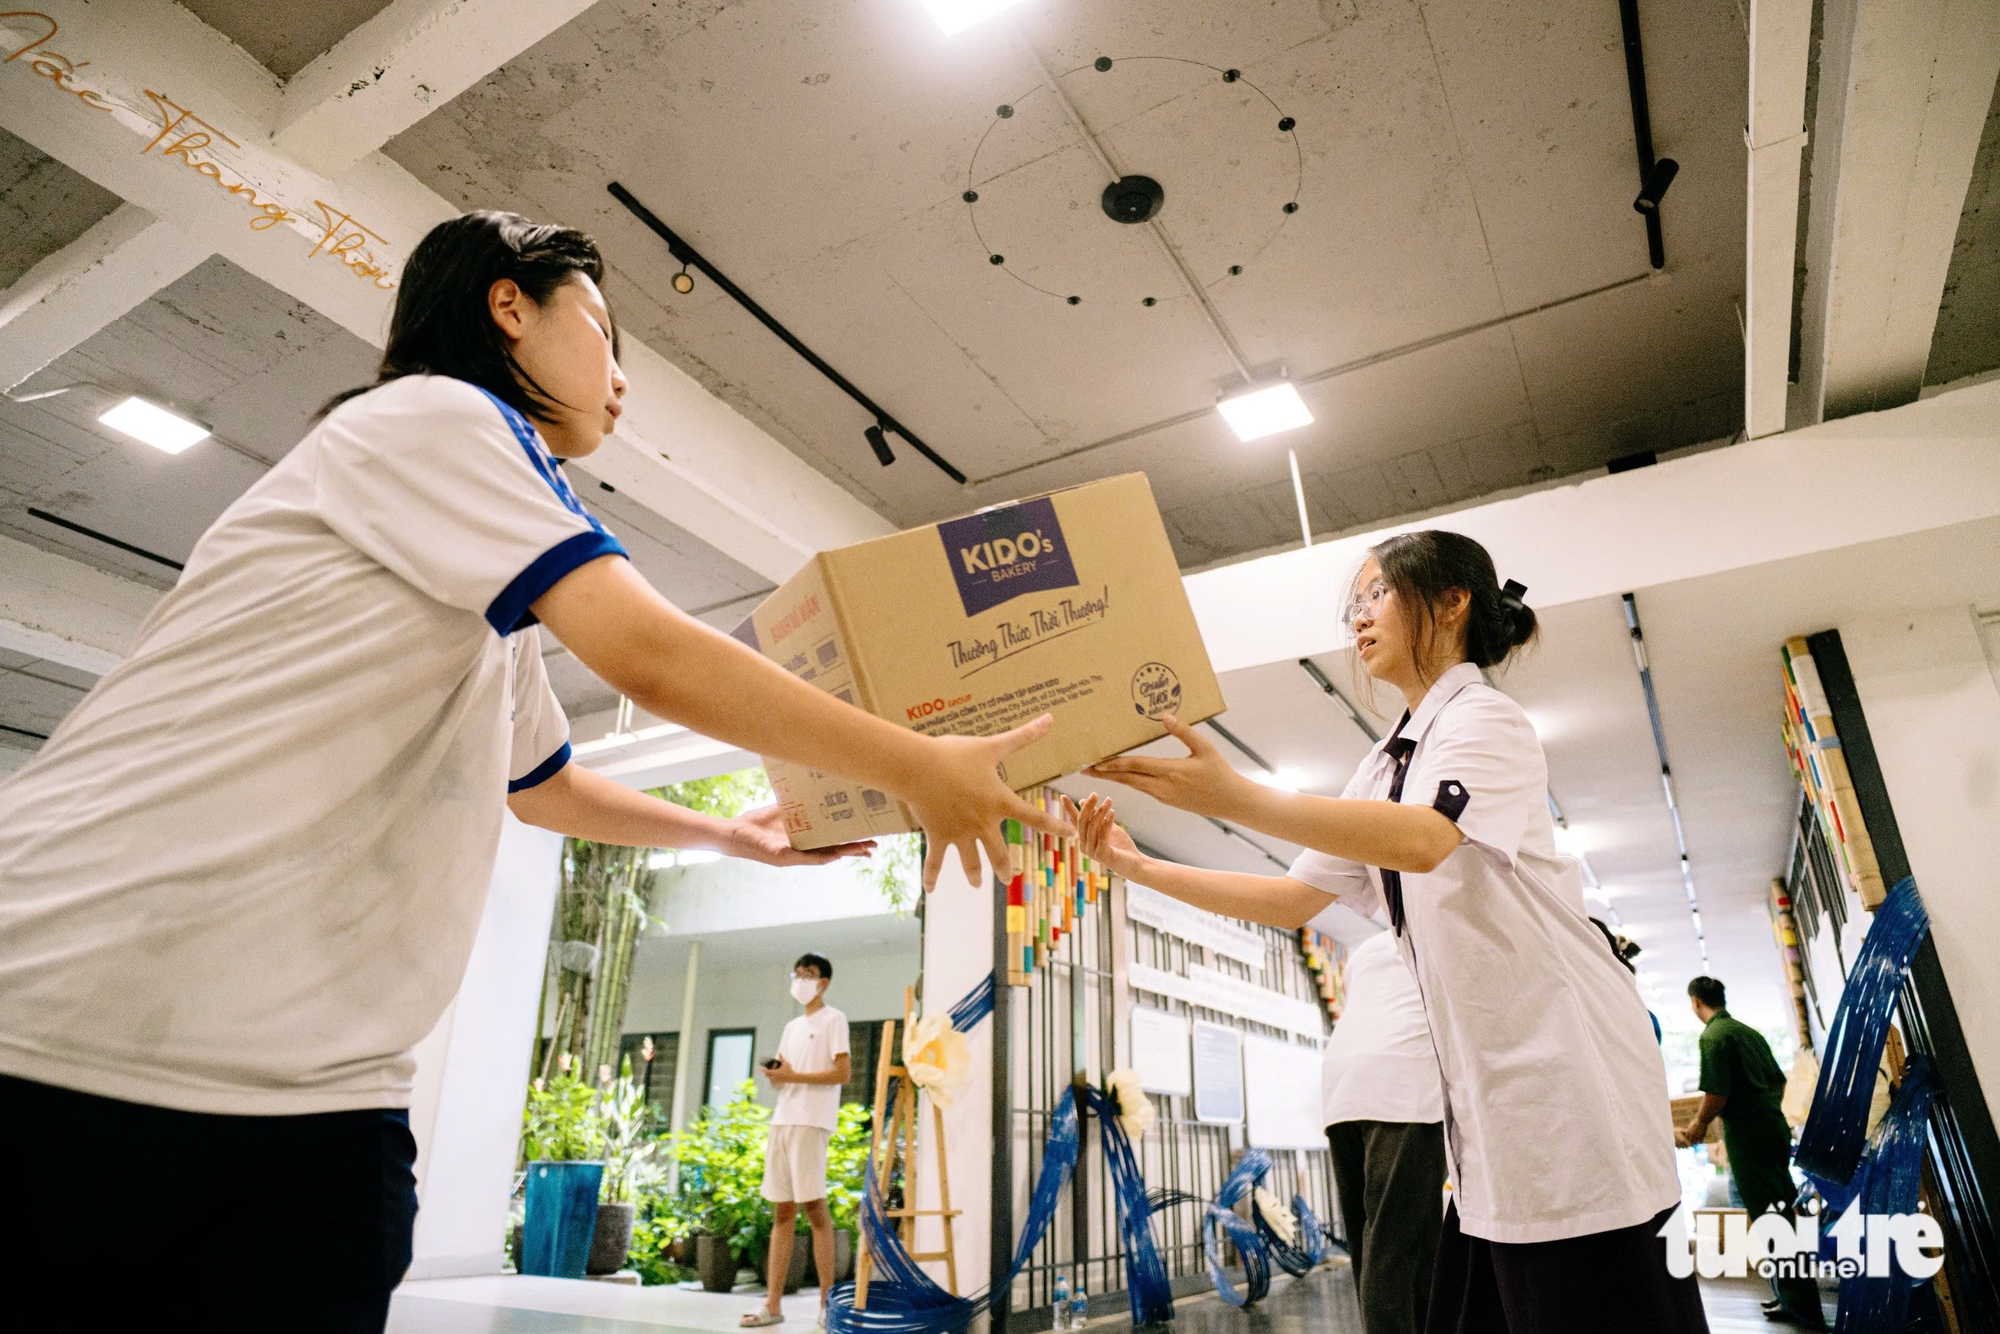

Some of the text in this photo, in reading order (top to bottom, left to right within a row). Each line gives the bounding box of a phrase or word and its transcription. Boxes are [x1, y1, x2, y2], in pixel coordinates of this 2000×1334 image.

[139, 88, 296, 231] Thang
[960, 529, 1054, 575] KIDO's
[990, 560, 1037, 583] BAKERY
[906, 694, 972, 721] KIDO GROUP
[978, 702, 987, 710] TY
